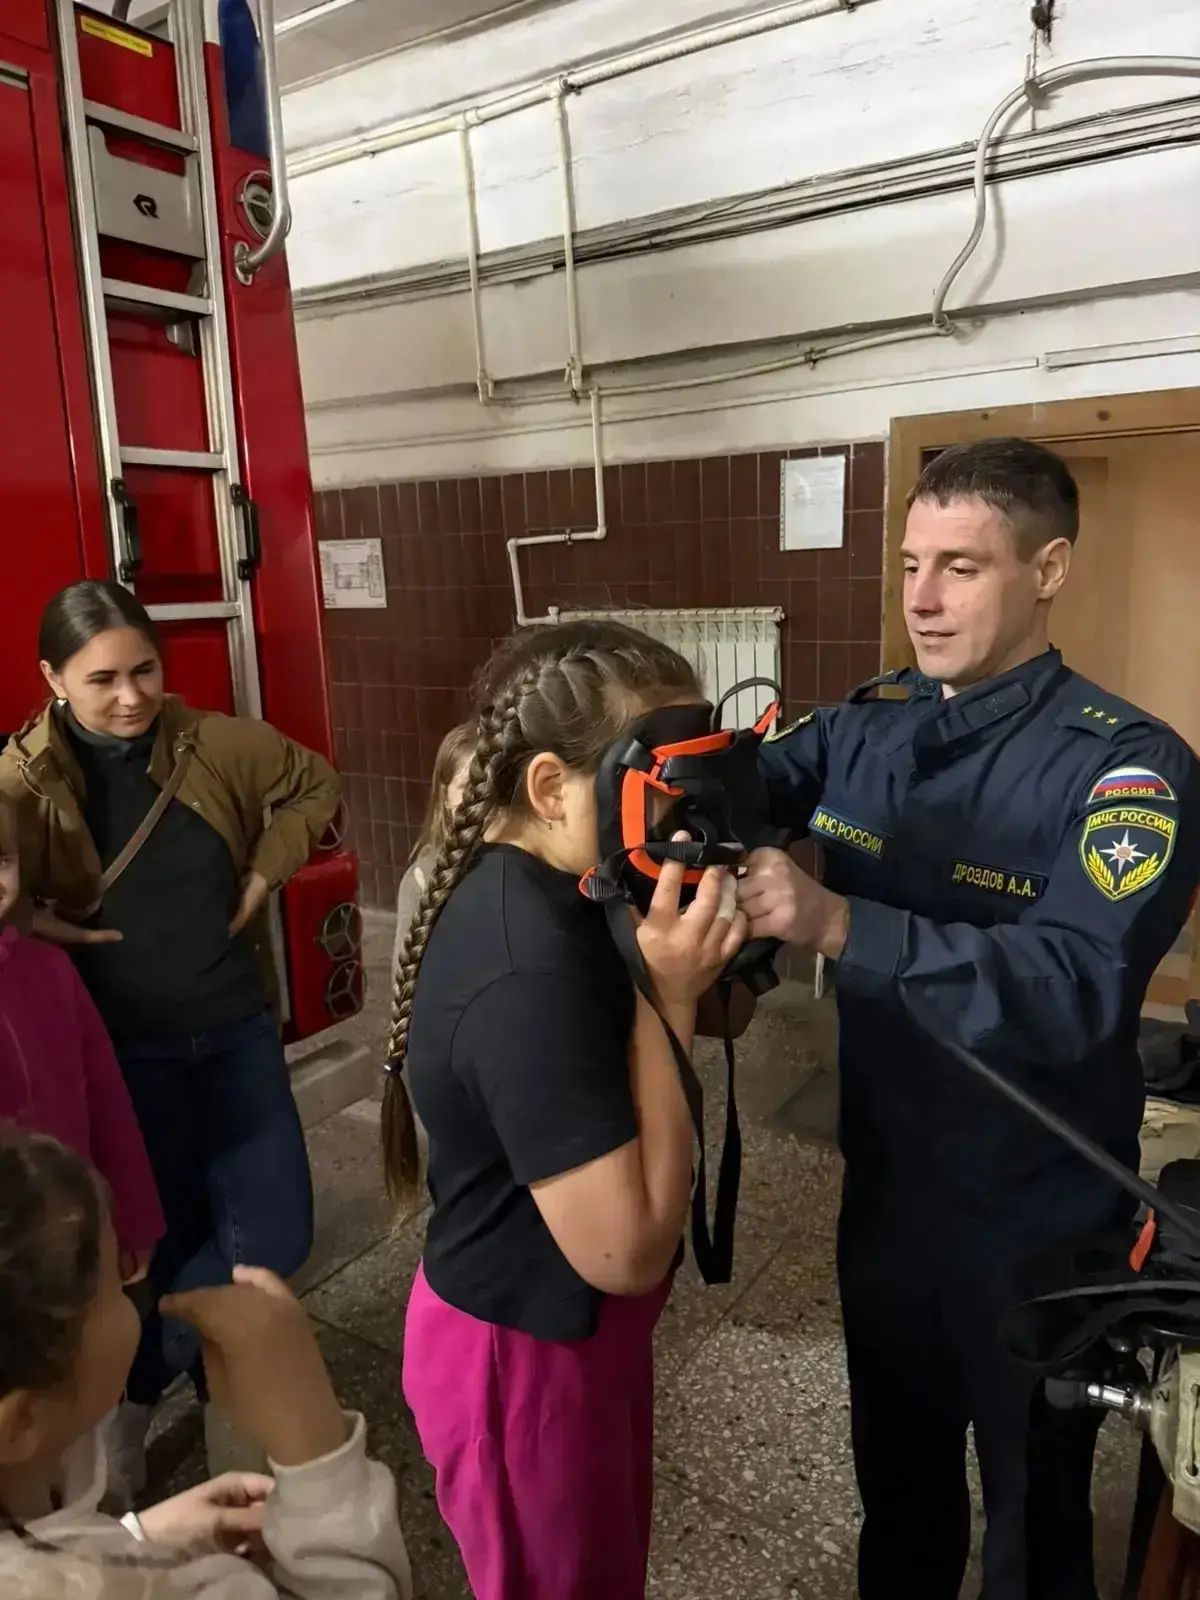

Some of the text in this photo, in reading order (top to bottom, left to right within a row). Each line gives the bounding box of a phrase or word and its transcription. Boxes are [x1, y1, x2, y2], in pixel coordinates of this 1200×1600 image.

[1105, 787, 1155, 798] РОССИЯ
[814, 811, 883, 854] МЧС РОССИИ
[1090, 811, 1172, 834] МЧС РОССИИ
[952, 863, 1037, 898] ДРОЗДОВ А.А.
